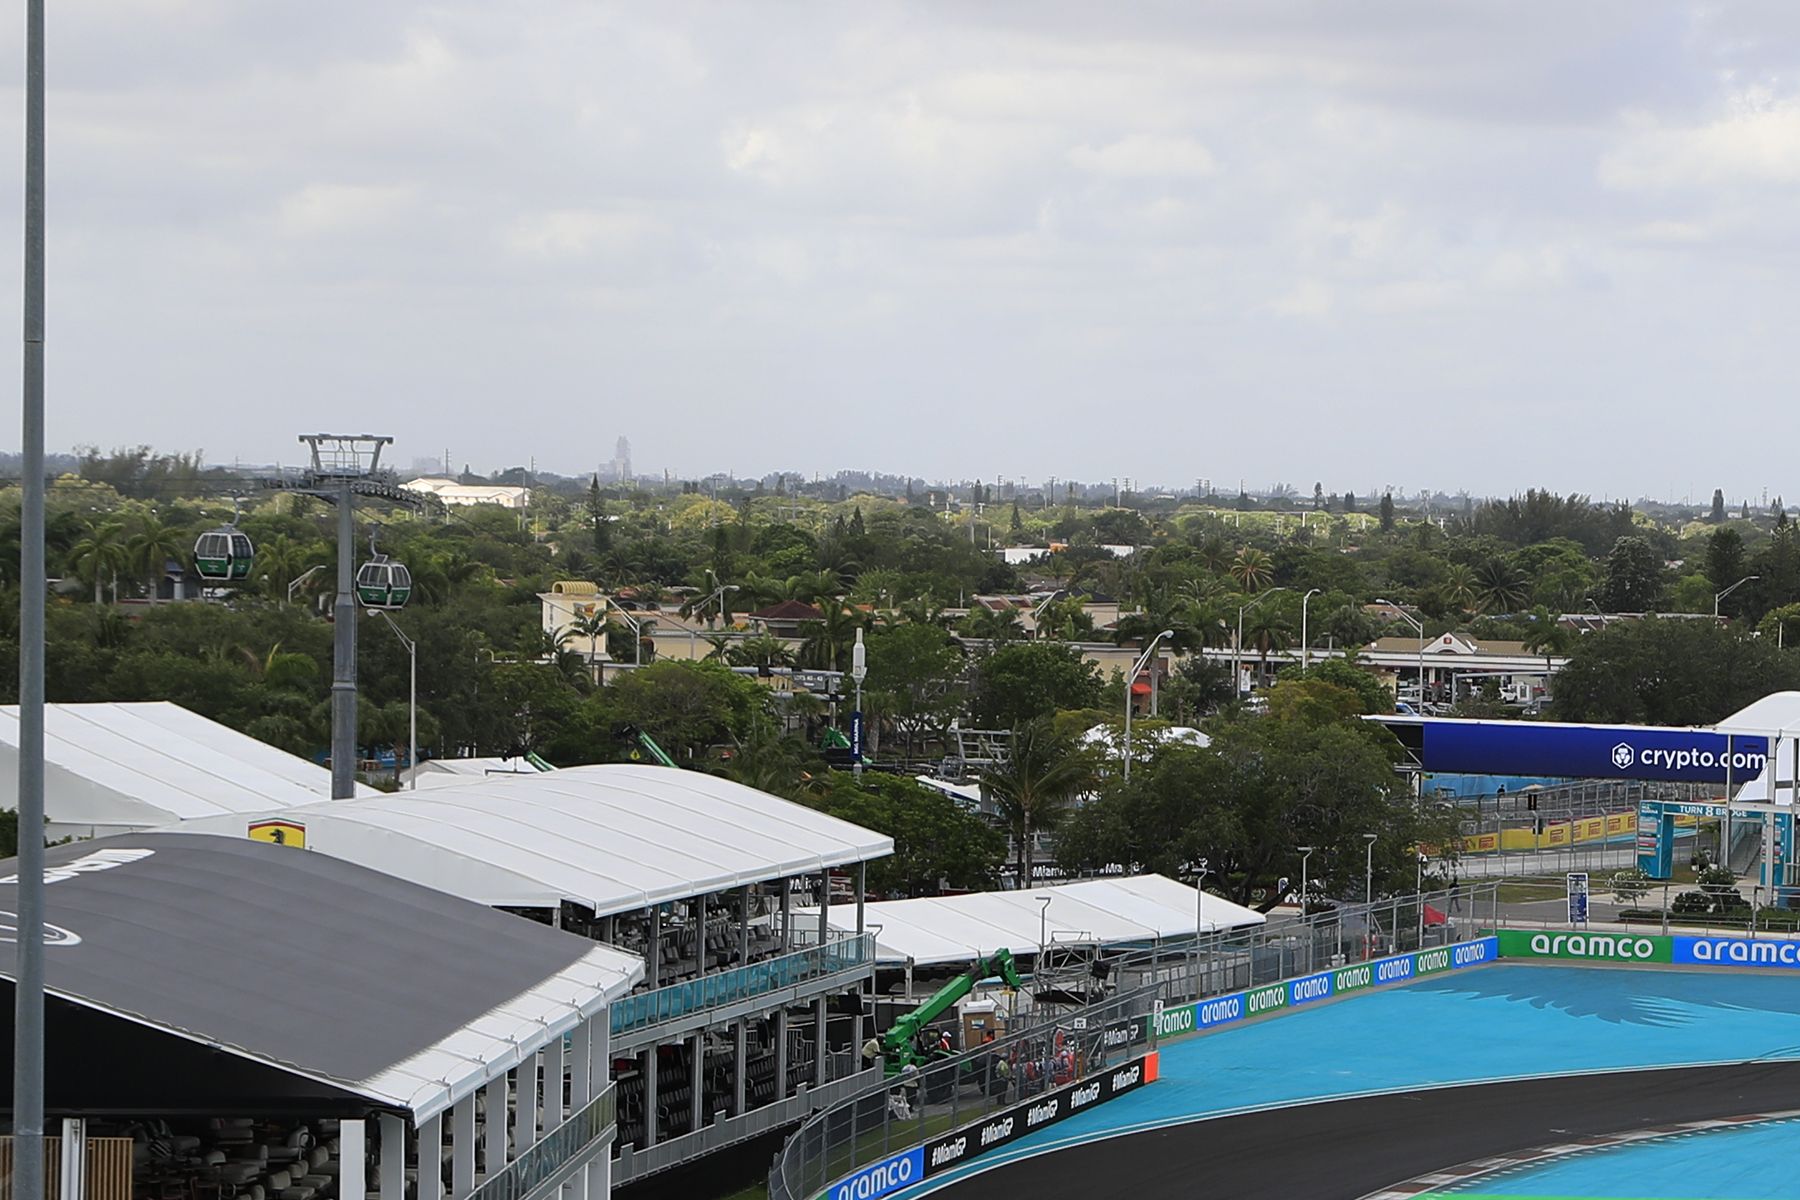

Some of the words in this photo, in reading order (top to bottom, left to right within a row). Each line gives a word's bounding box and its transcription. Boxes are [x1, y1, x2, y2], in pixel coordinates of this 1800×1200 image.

[1641, 748, 1766, 769] crypto.com
[1679, 805, 1703, 815] TURN
[1705, 806, 1714, 817] 8
[1455, 944, 1485, 965] aramco
[1530, 931, 1654, 961] aramco
[1378, 958, 1411, 982] aramco
[1418, 950, 1448, 972] aramco
[1294, 977, 1328, 1001] aramco
[1337, 966, 1371, 991] aramco
[1201, 998, 1240, 1024] aramco
[1249, 986, 1285, 1013] aramco
[1112, 1065, 1140, 1092] #MiamiGP
[1070, 1082, 1100, 1109] #MiamiGP
[1027, 1099, 1058, 1127] #MiamiGP
[981, 1117, 1014, 1146] #MiamiGP
[931, 1136, 967, 1167] #MiamiGP
